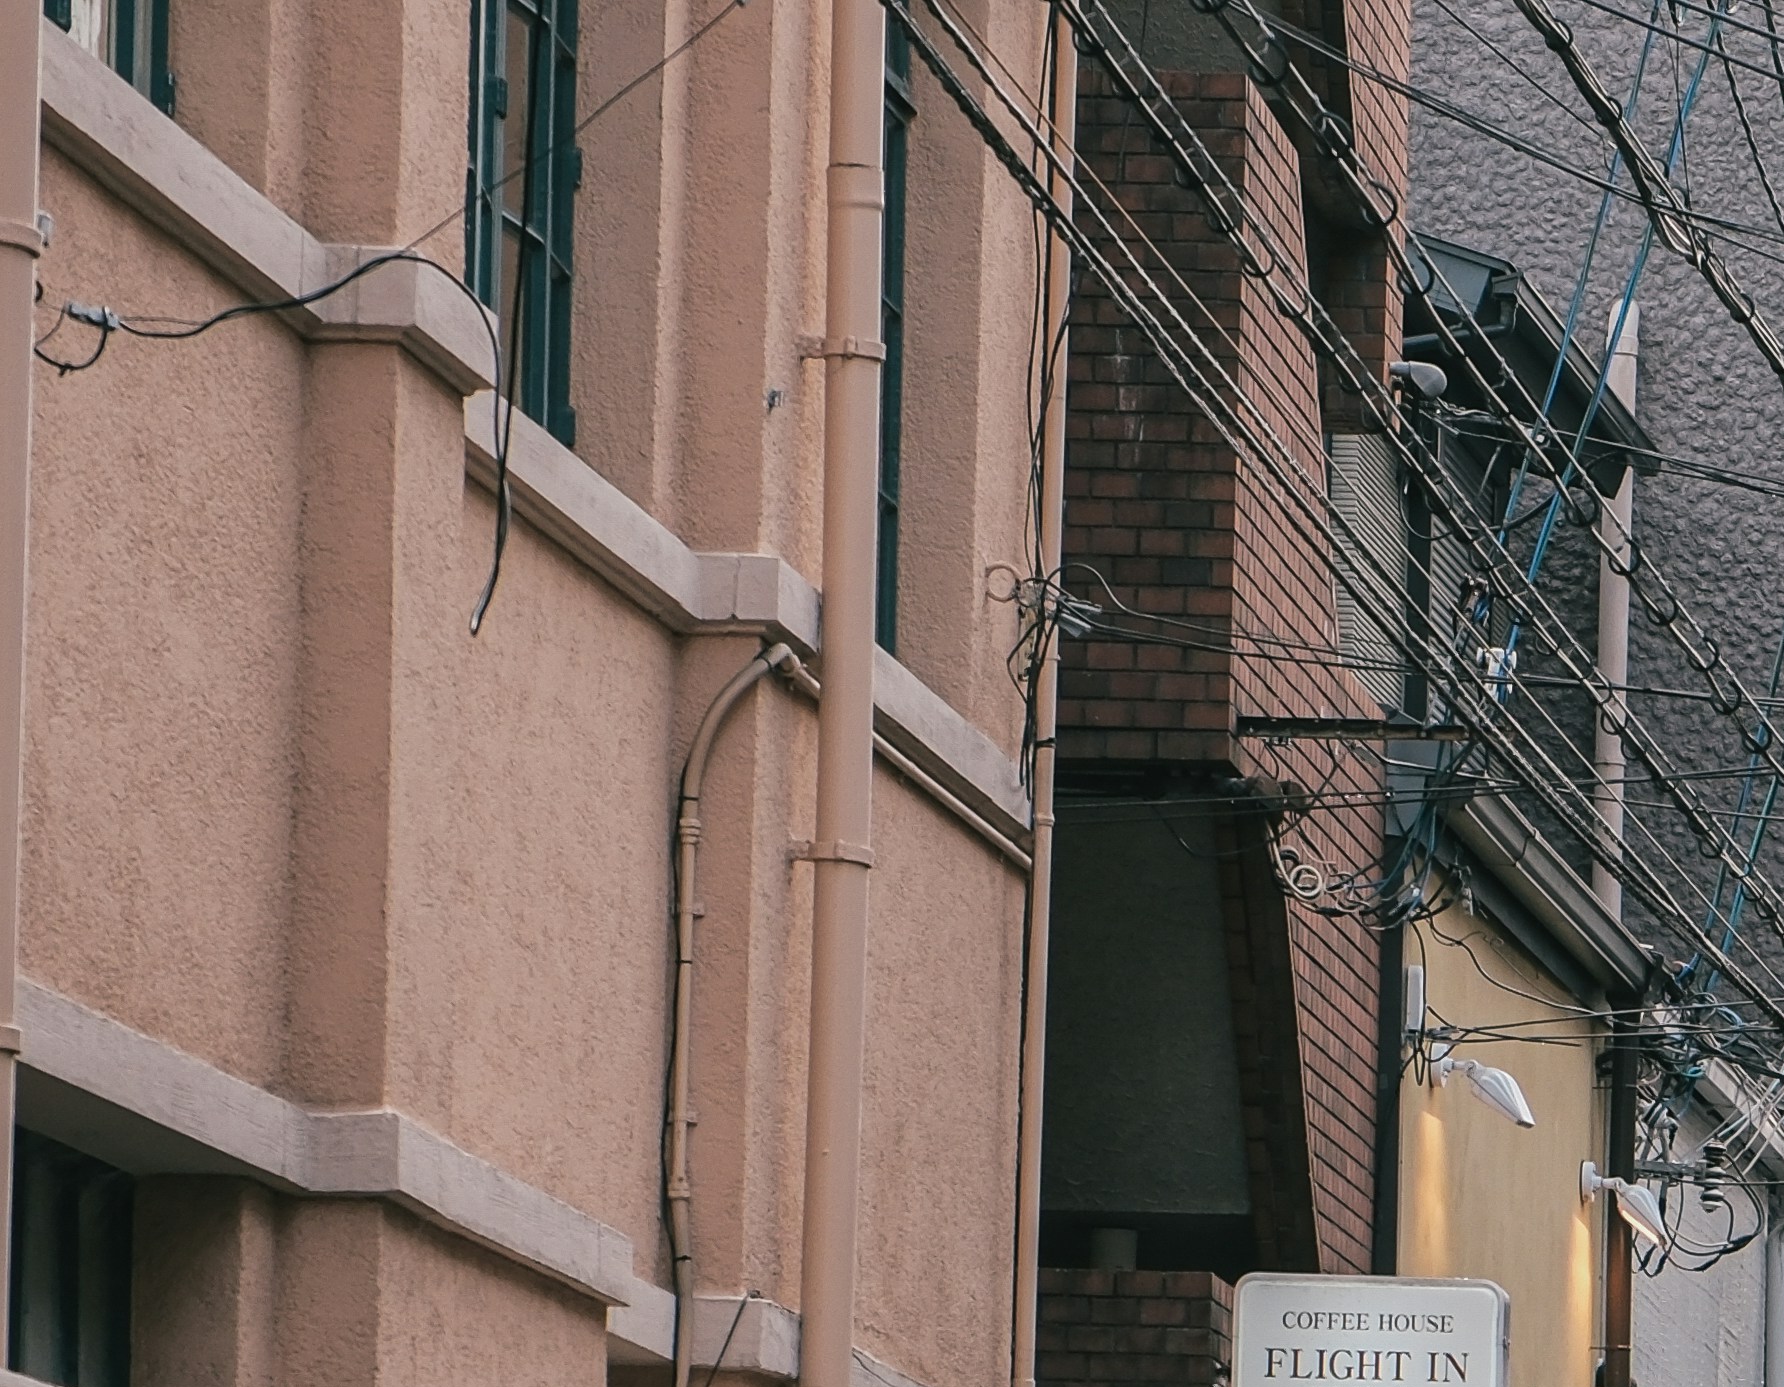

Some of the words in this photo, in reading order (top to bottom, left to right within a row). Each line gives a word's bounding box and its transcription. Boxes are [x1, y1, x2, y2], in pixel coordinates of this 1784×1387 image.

[1282, 1311, 1369, 1331] COFFEE
[1379, 1314, 1454, 1333] HOUSE
[1264, 1347, 1412, 1381] FLIGHT
[1427, 1351, 1469, 1382] IN
